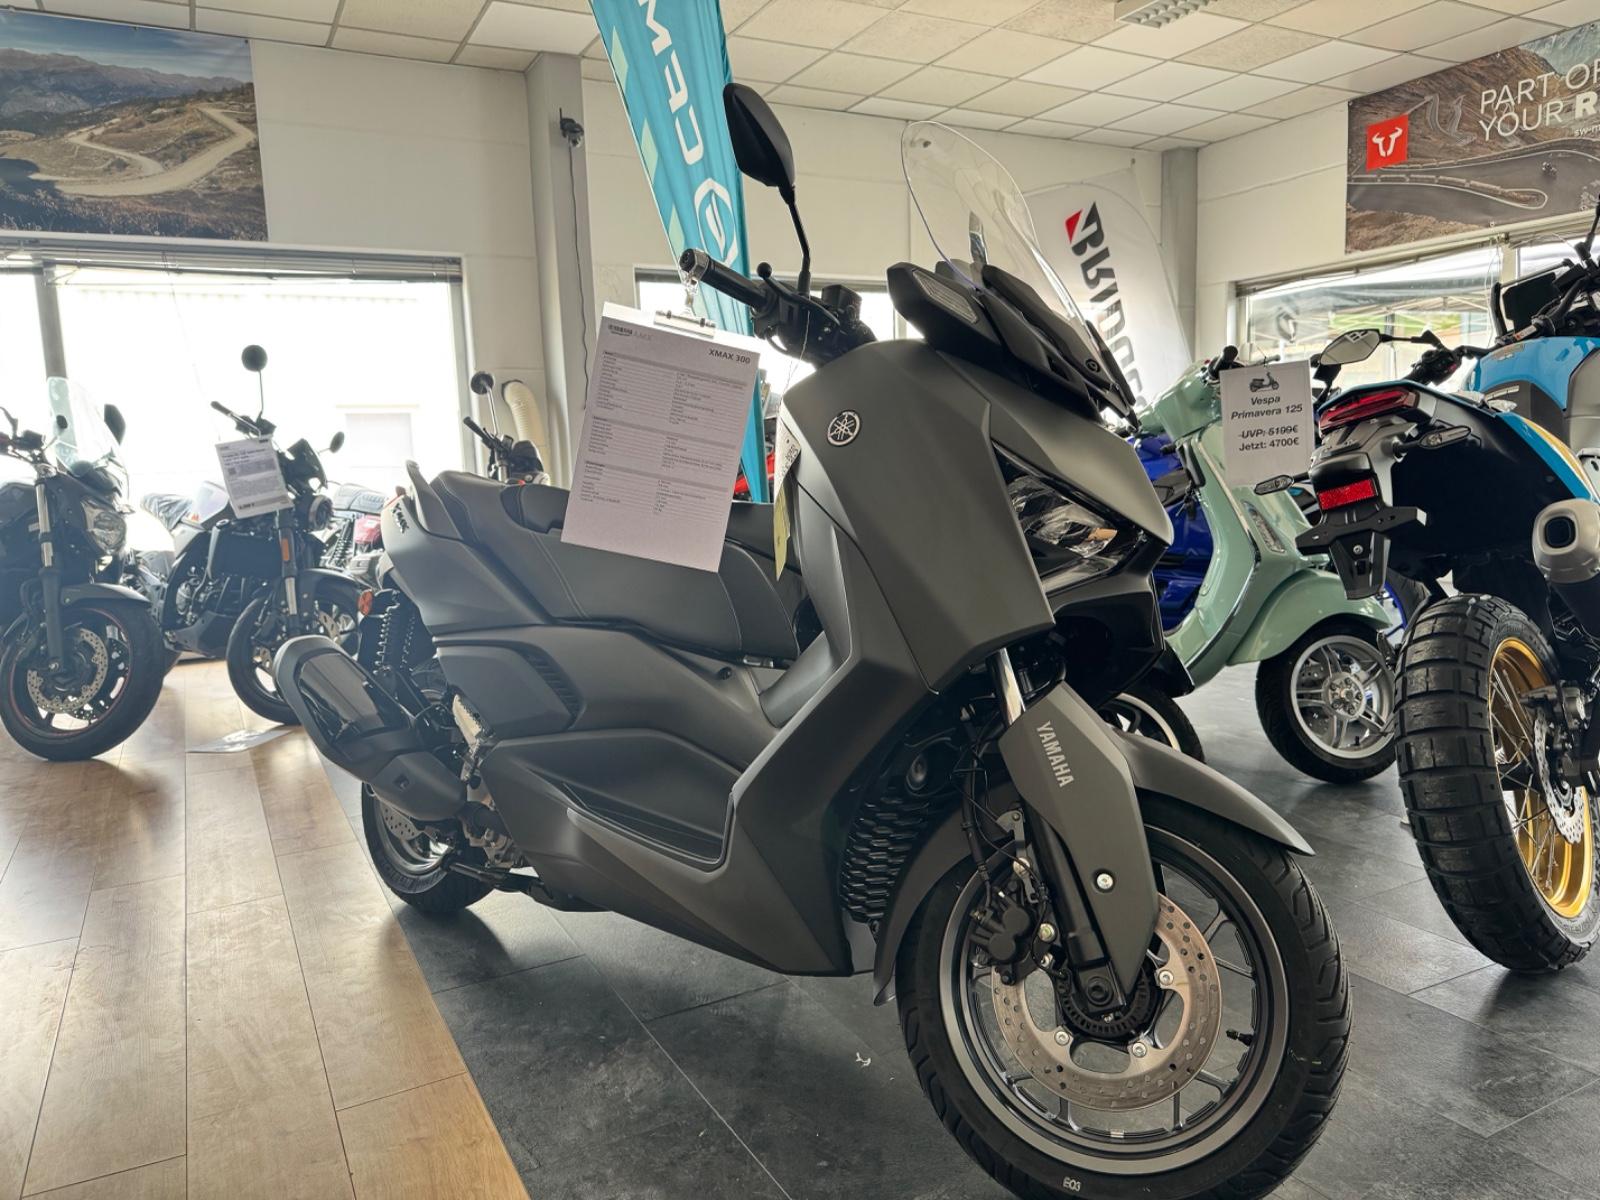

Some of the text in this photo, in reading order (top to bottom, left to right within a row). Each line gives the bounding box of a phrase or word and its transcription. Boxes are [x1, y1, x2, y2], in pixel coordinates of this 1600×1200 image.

[1481, 71, 1555, 114] PART
[1479, 100, 1564, 141] YOUR
[709, 348, 751, 364] XMAX 300
[1251, 396, 1281, 406] Vespa
[1231, 404, 1303, 420] Primavera 125
[1239, 437, 1300, 451] Jetzt: 4700€
[1036, 720, 1074, 787] YAMAHA
